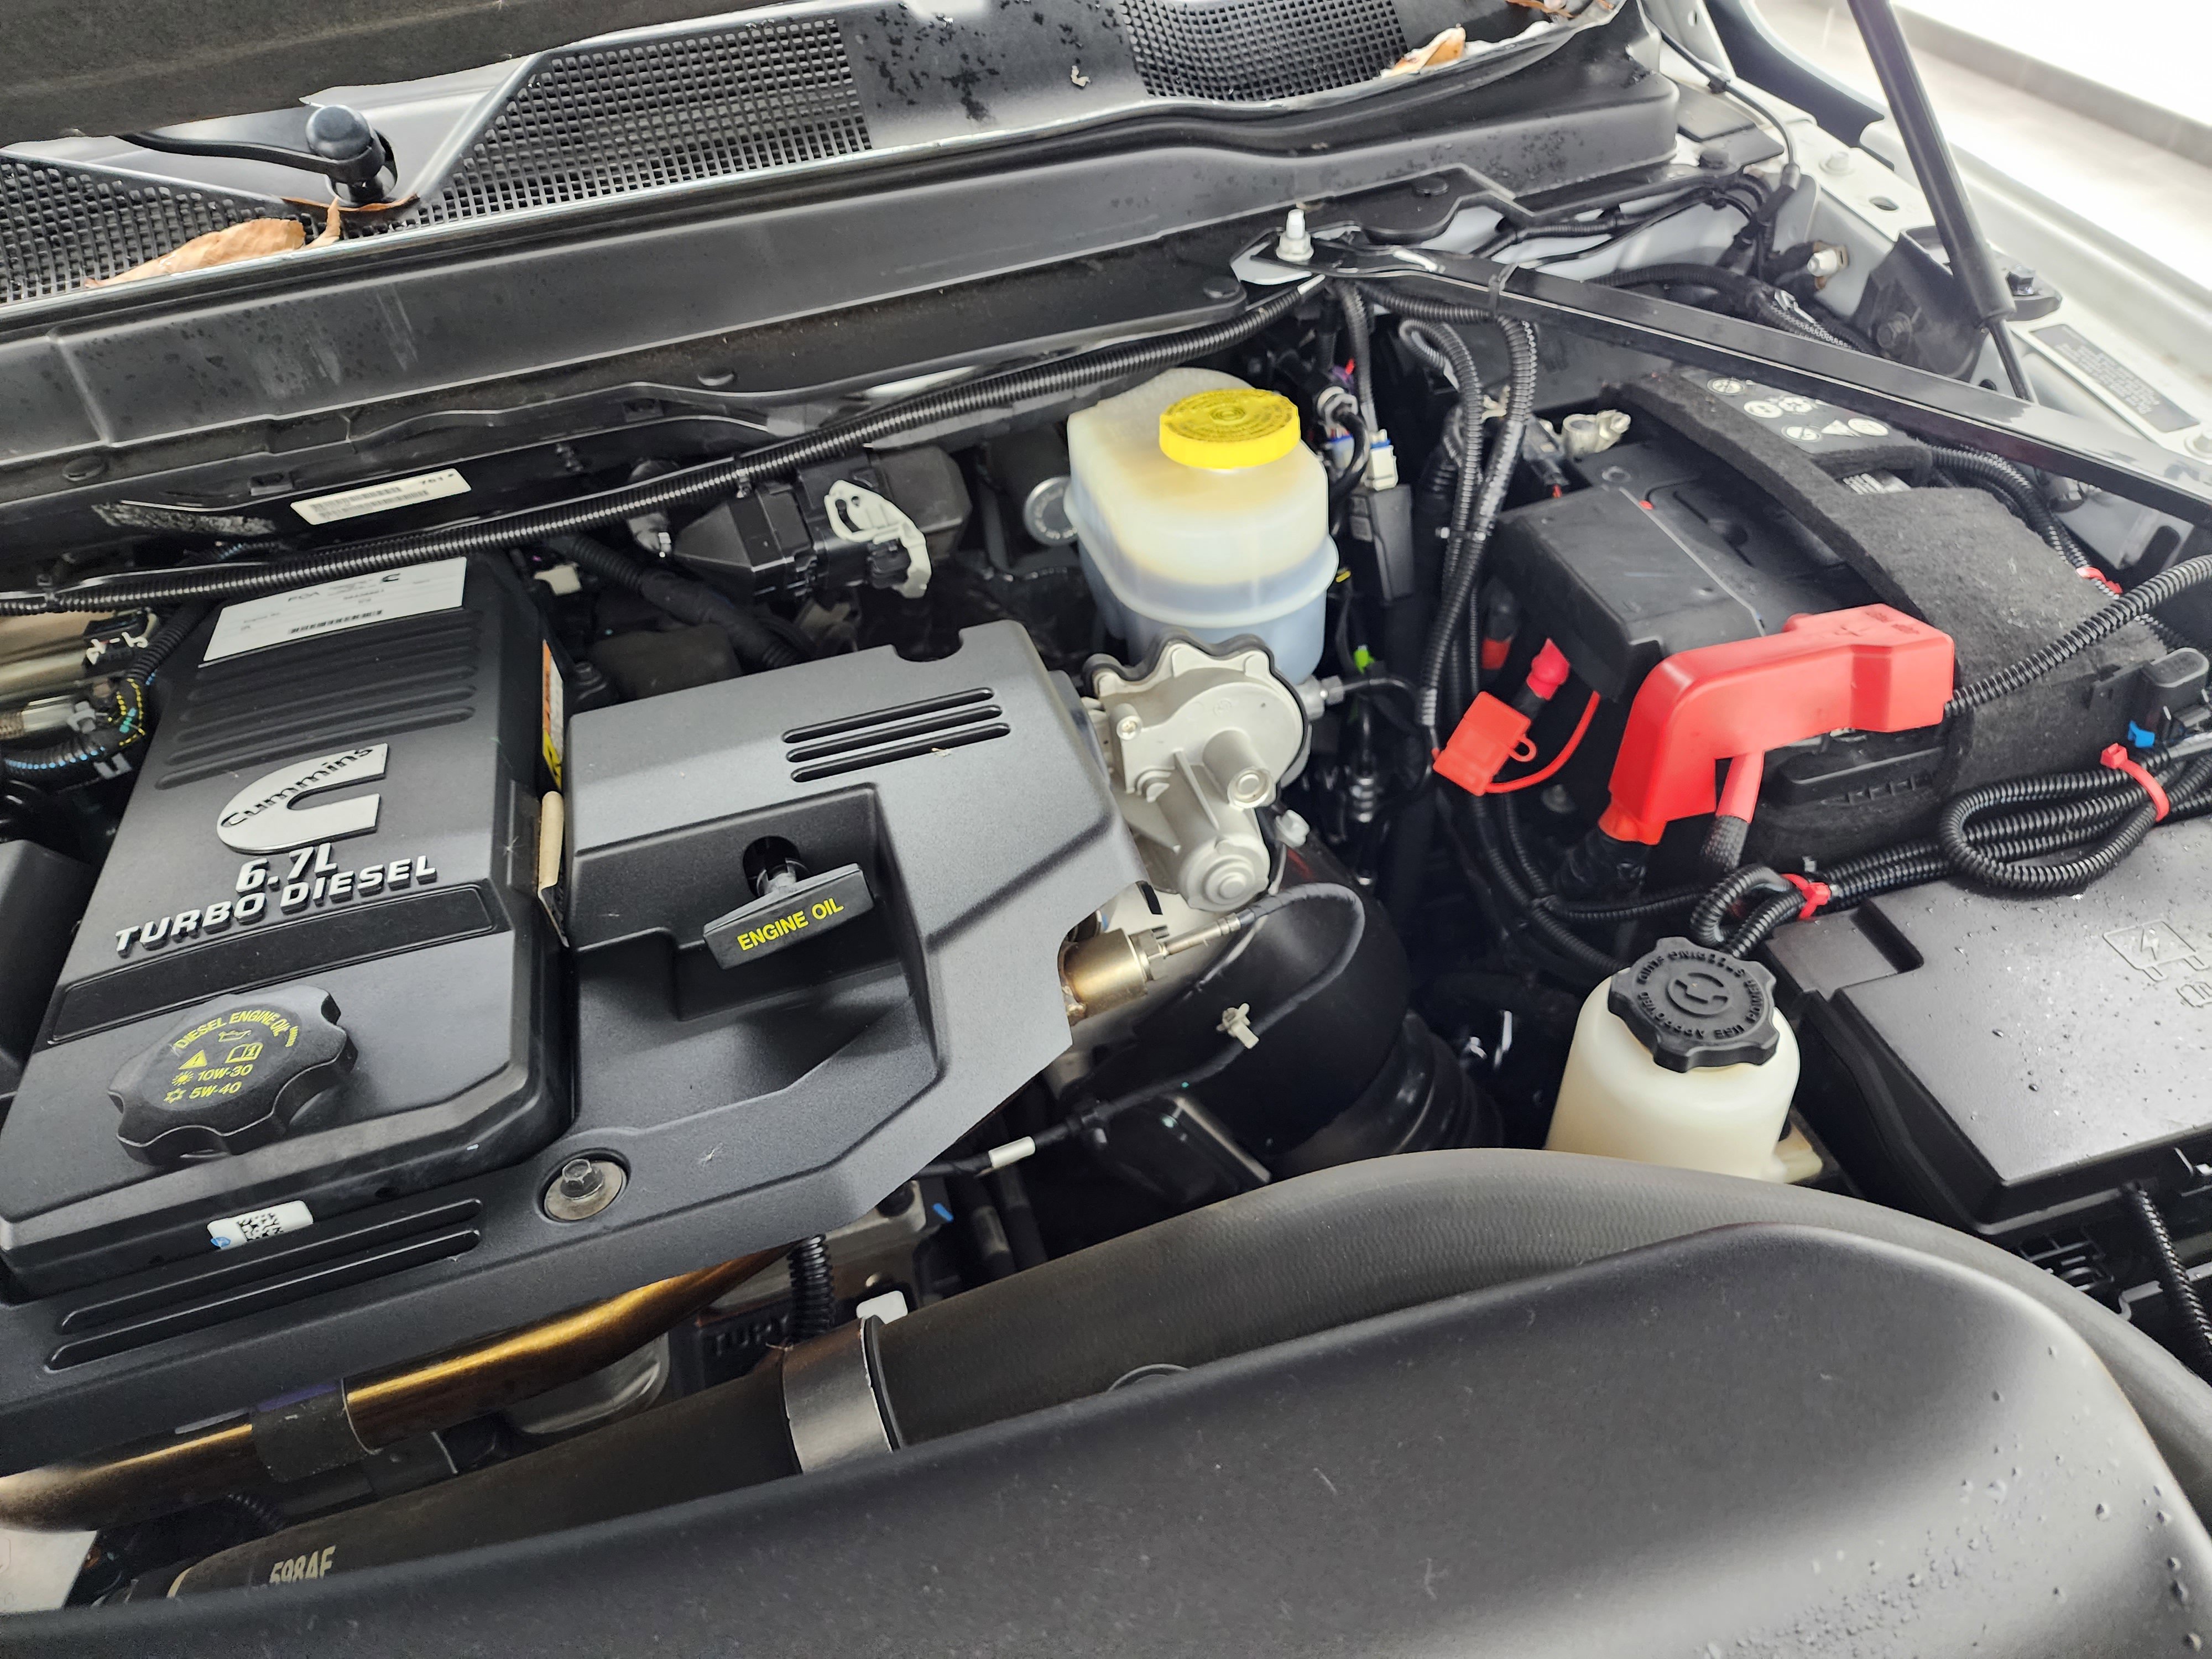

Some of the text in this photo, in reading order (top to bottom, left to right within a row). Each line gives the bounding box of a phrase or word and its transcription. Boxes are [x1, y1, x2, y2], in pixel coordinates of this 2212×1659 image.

[221, 748, 373, 828] Cummins
[235, 842, 338, 894] 6.7L
[115, 855, 437, 957] TURBO DIESEL
[737, 898, 845, 951] ENGINE OIL
[172, 1018, 227, 1048] DIESEL
[228, 1010, 280, 1025] ENGINE
[270, 1019, 291, 1037] OIL
[189, 1081, 242, 1099] 5W-40
[197, 1064, 254, 1082] 10W-30
